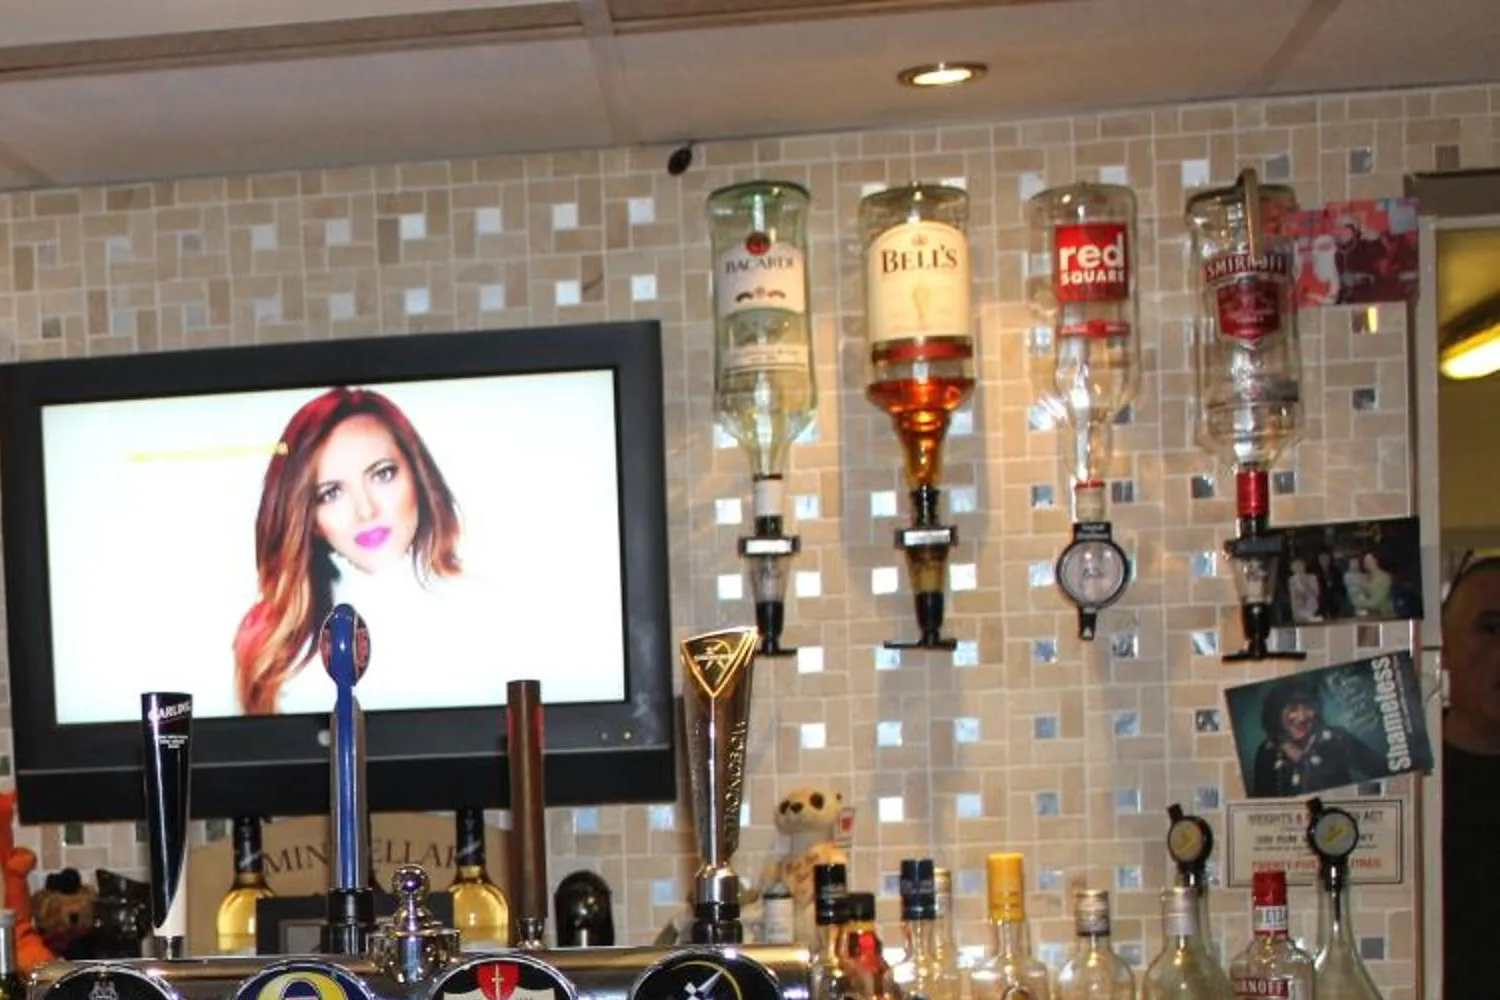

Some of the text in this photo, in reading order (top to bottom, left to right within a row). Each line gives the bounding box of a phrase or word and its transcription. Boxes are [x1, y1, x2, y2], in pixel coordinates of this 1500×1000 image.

[724, 255, 794, 274] BACARDI
[881, 246, 959, 274] BELL'S
[1059, 232, 1124, 269] red
[1370, 656, 1412, 772] Shameless
